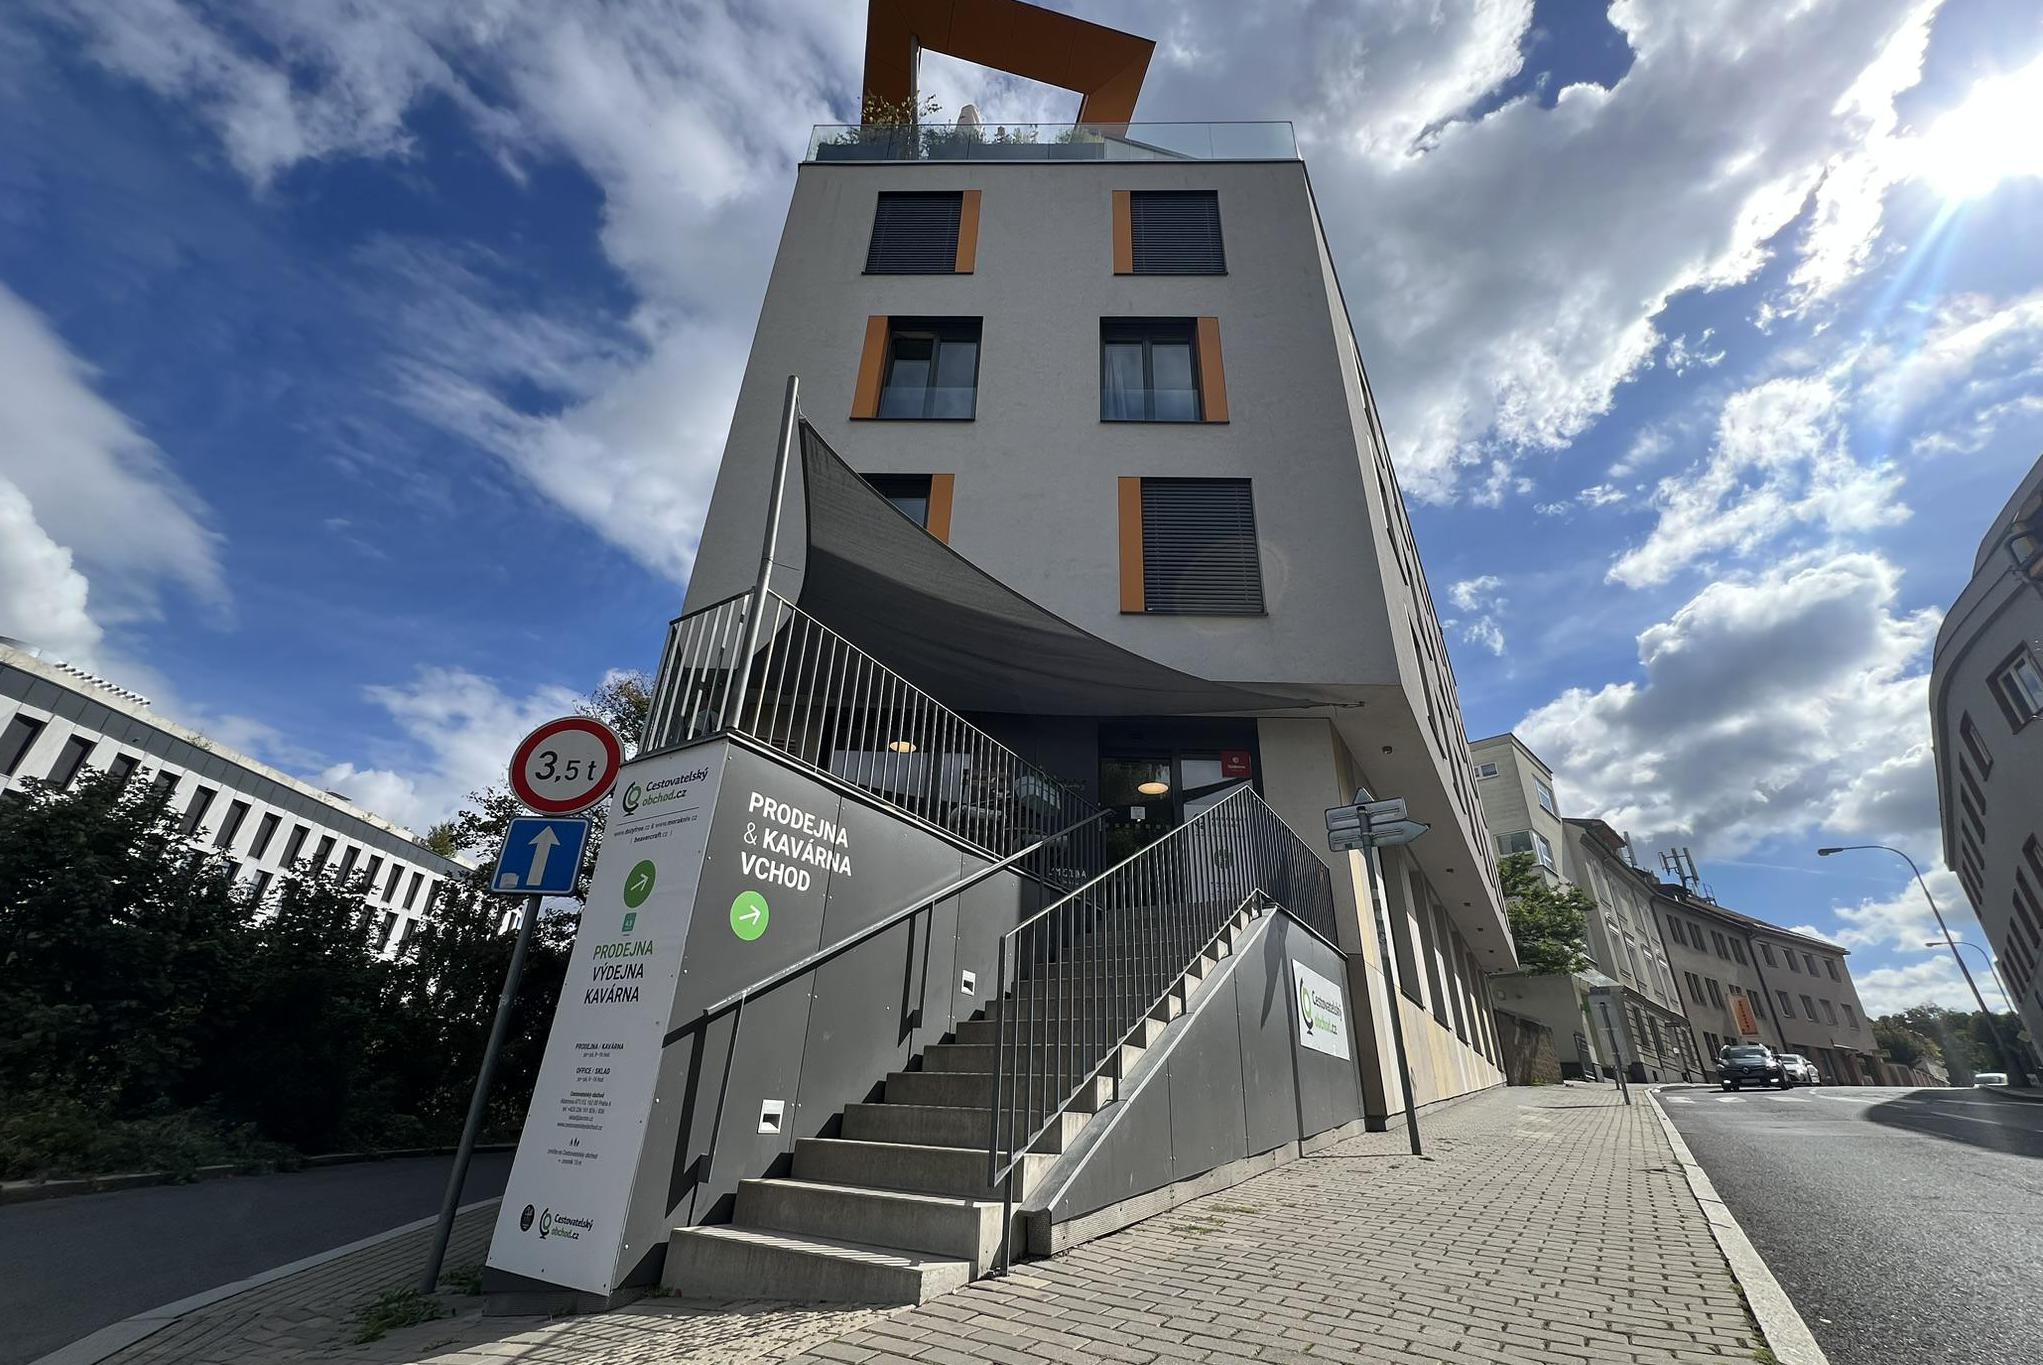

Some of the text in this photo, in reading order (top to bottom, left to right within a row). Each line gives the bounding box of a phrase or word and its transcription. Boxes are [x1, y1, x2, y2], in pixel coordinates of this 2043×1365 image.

[535, 751, 597, 783] 3,5 t
[646, 766, 709, 792] Cestovatelský
[642, 789, 687, 807] obchod.cz
[748, 791, 849, 849] PRODEJNA
[743, 821, 852, 877] & KAVÁRNA
[741, 851, 811, 892] VCHOD
[593, 940, 653, 960] PRODEJNA
[593, 962, 644, 982] VÝDEJNA
[583, 983, 639, 1004] KAVÁRNA
[554, 1213, 594, 1232] Cestovatelský
